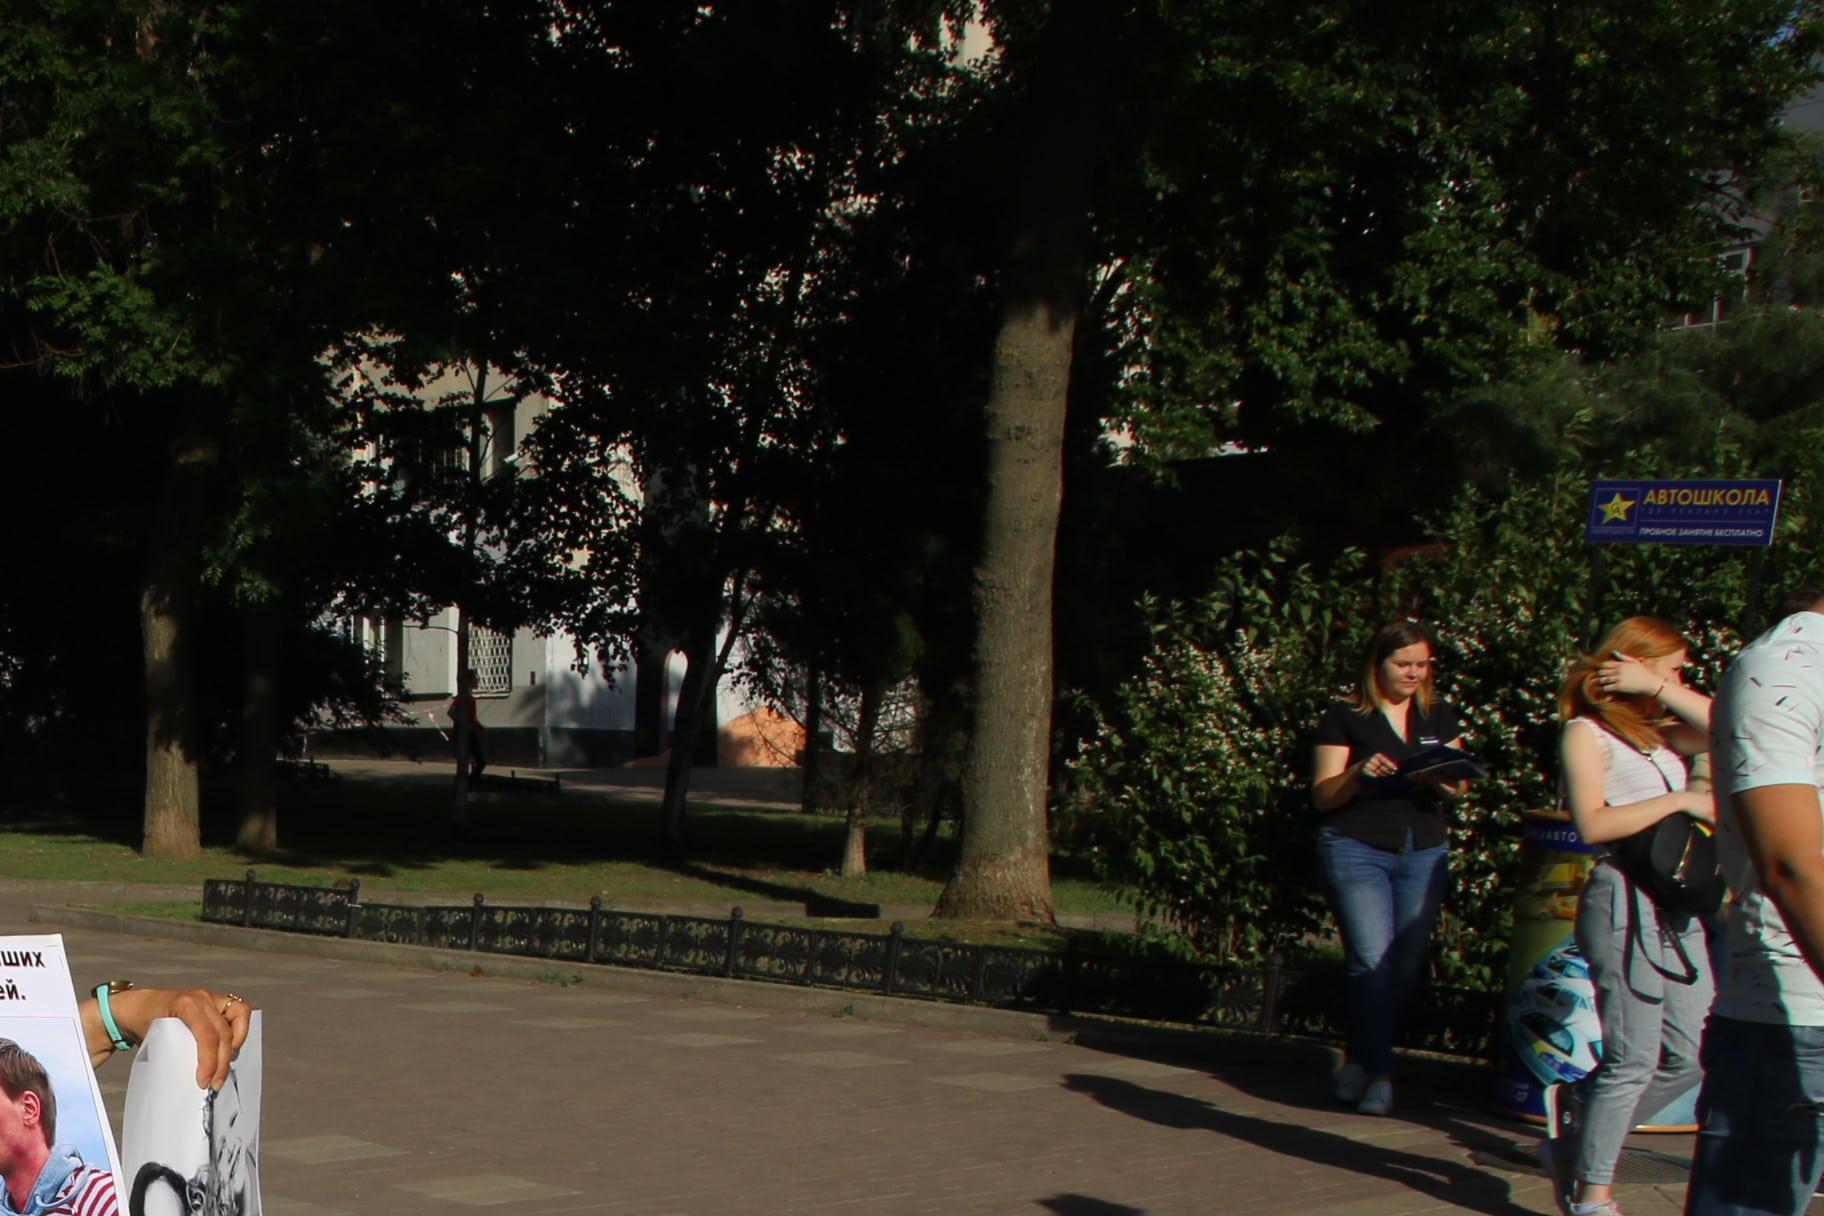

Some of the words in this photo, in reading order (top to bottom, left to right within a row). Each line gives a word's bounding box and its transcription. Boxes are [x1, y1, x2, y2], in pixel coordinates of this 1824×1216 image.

[1643, 488, 1770, 506] АВТОШКОЛА
[1639, 527, 1677, 537] ПРОБНОЕ
[1678, 528, 1713, 537] ЗАНЯТИЕ
[1714, 528, 1764, 538] БЕСПЛАТНО
